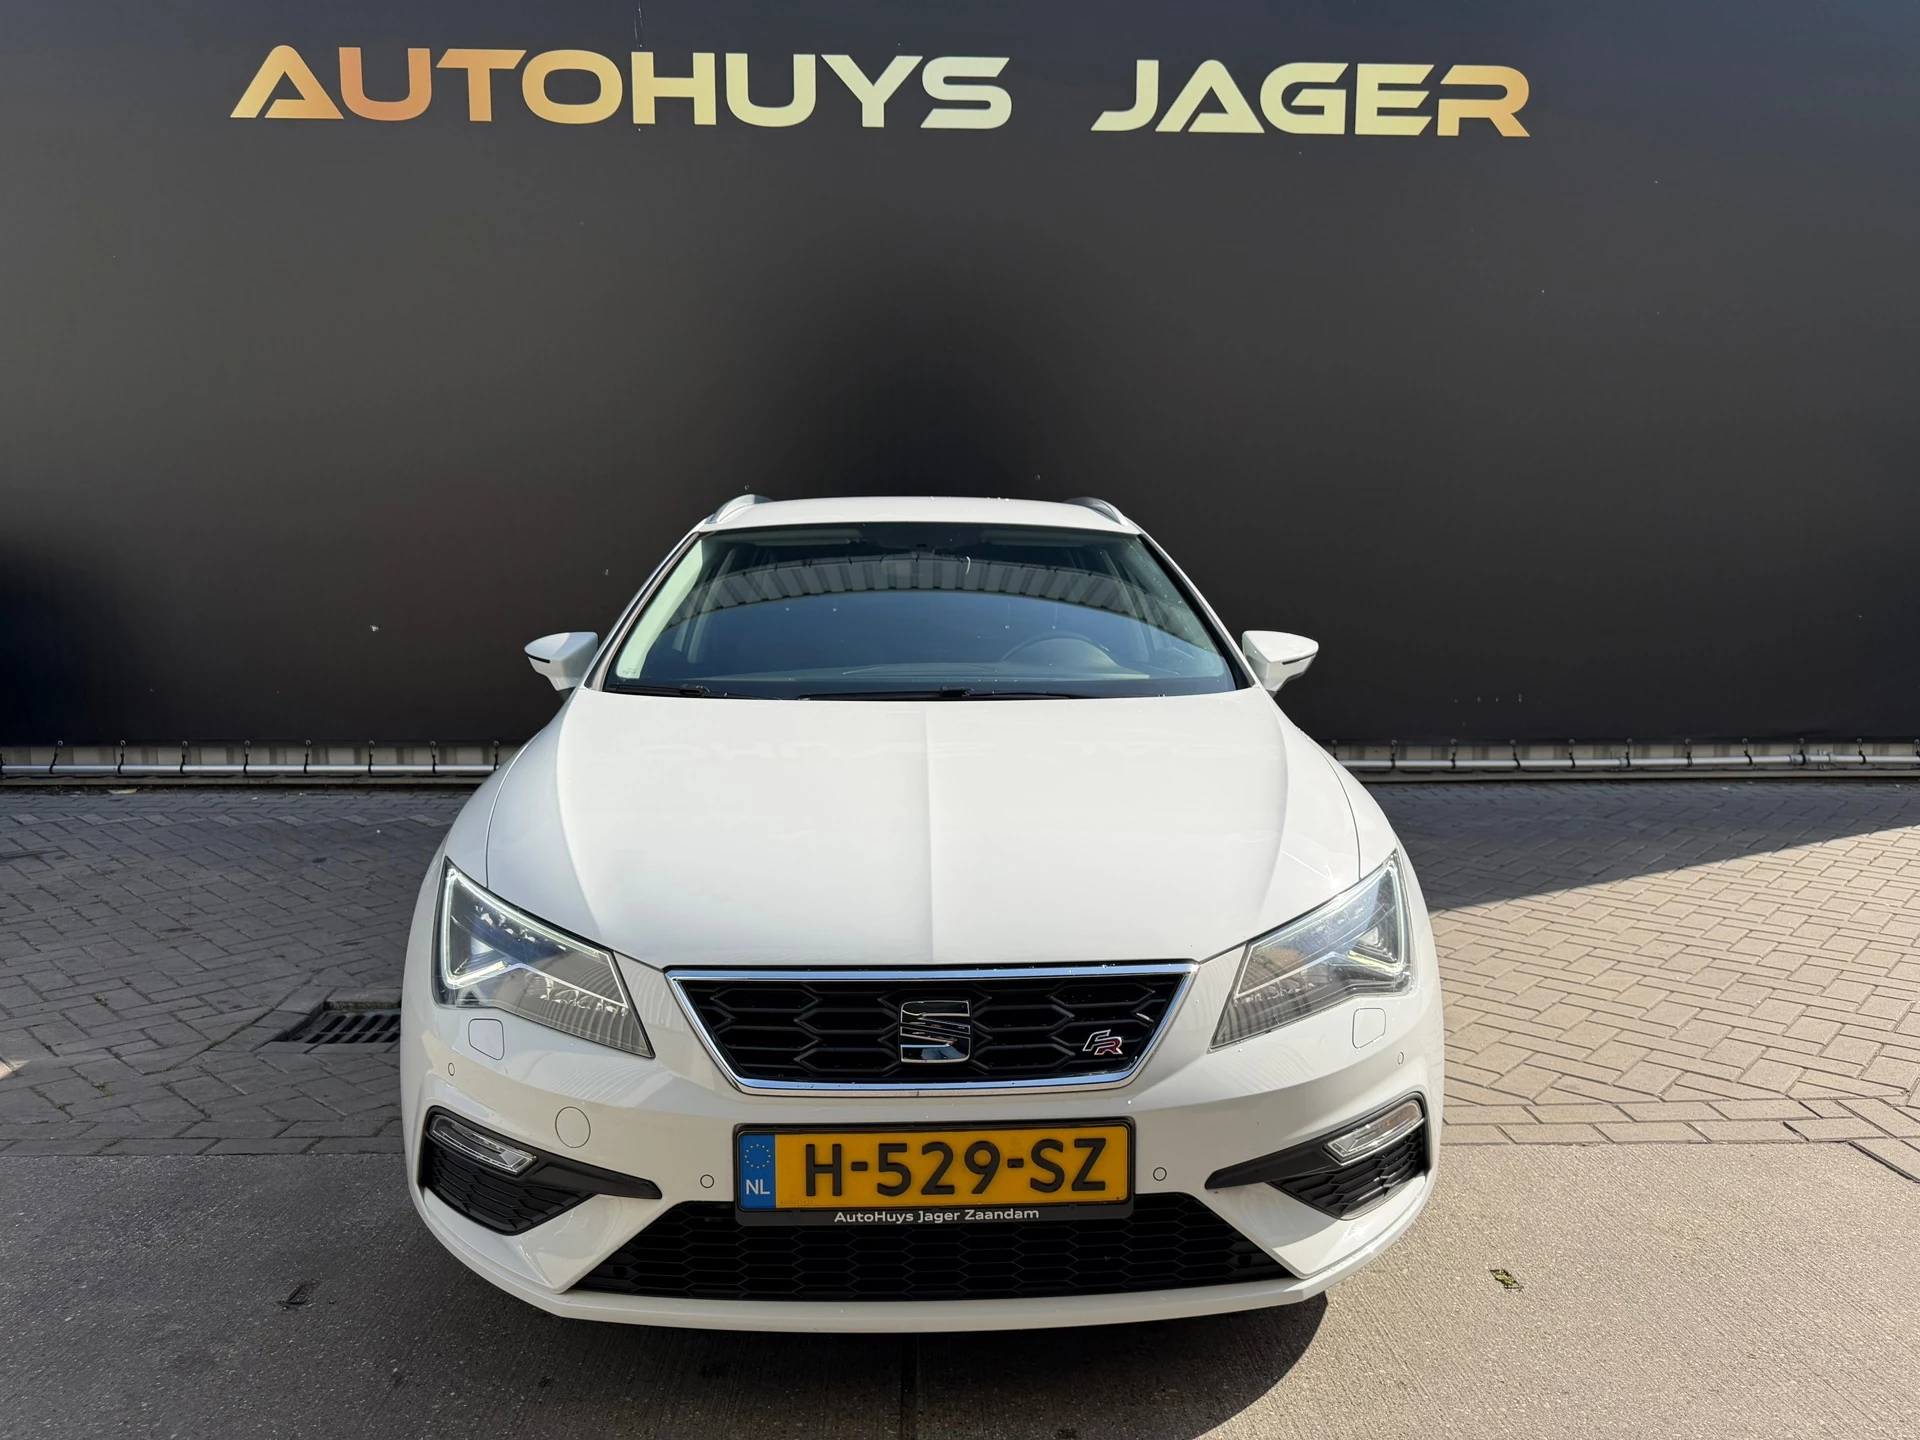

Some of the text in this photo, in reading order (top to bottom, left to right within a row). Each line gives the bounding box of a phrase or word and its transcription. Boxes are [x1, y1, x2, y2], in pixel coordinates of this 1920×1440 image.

[230, 44, 1530, 137] AUTOHUYS JAGER
[1082, 1029, 1123, 1055] FR
[805, 1138, 1107, 1196] H-529-SZ
[745, 1179, 770, 1194] NL
[834, 1208, 1039, 1224] AutoHuys Jager Zaandam
